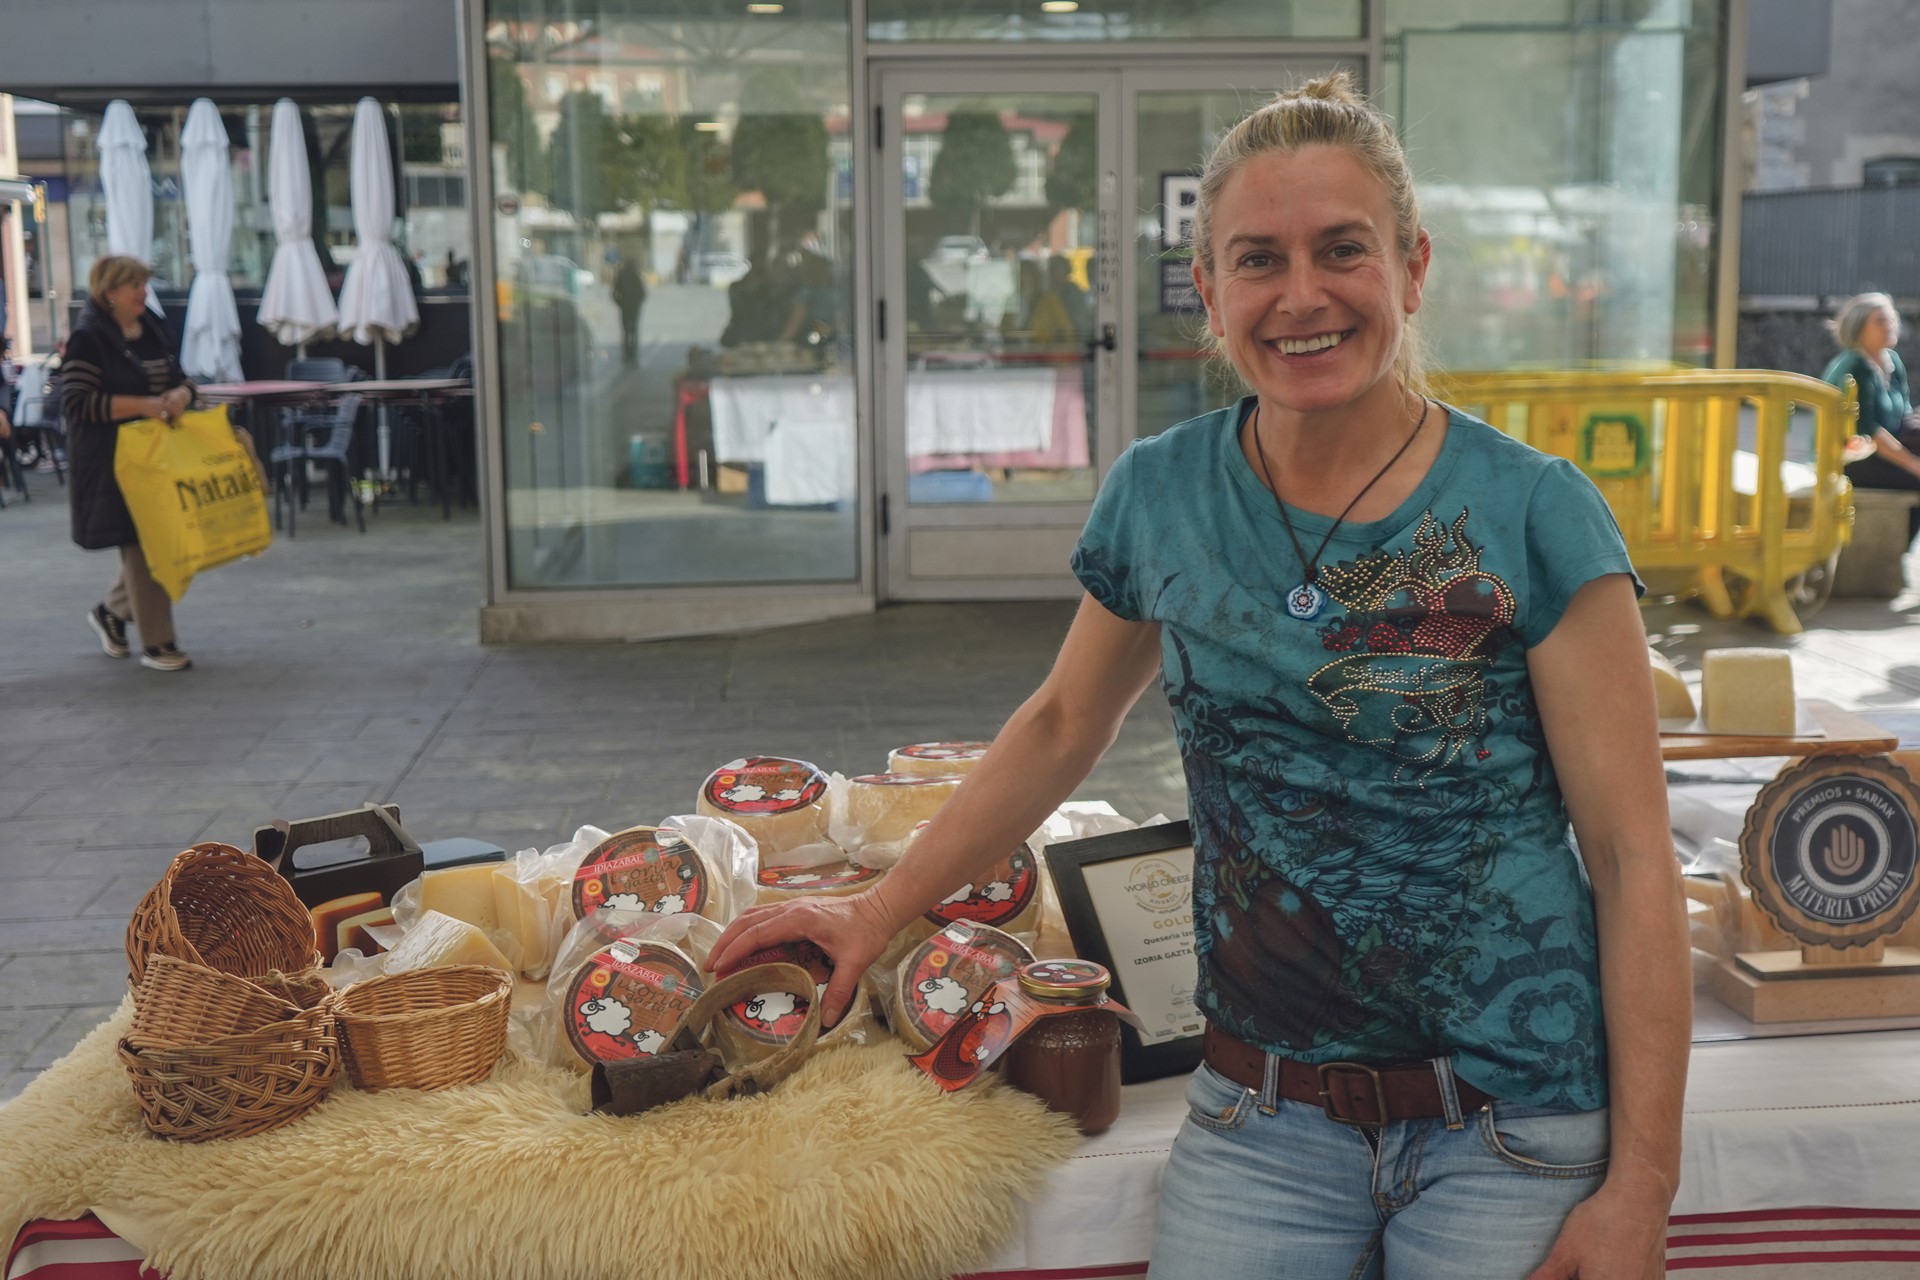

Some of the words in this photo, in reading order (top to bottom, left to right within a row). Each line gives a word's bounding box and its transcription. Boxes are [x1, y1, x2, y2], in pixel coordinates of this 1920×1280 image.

[1791, 786, 1843, 823] PREMIOS
[1855, 787, 1897, 820] SARIAK
[594, 856, 642, 874] IDIAZABAL
[1124, 878, 1160, 893] WORLD
[1785, 873, 1854, 918] MATERIA
[1858, 869, 1906, 914] PRIMA
[1153, 914, 1193, 930] GOLD
[1134, 954, 1163, 966] IZORIA
[1164, 948, 1193, 959] GAZTA
[611, 960, 661, 984] IDIAZABAL
